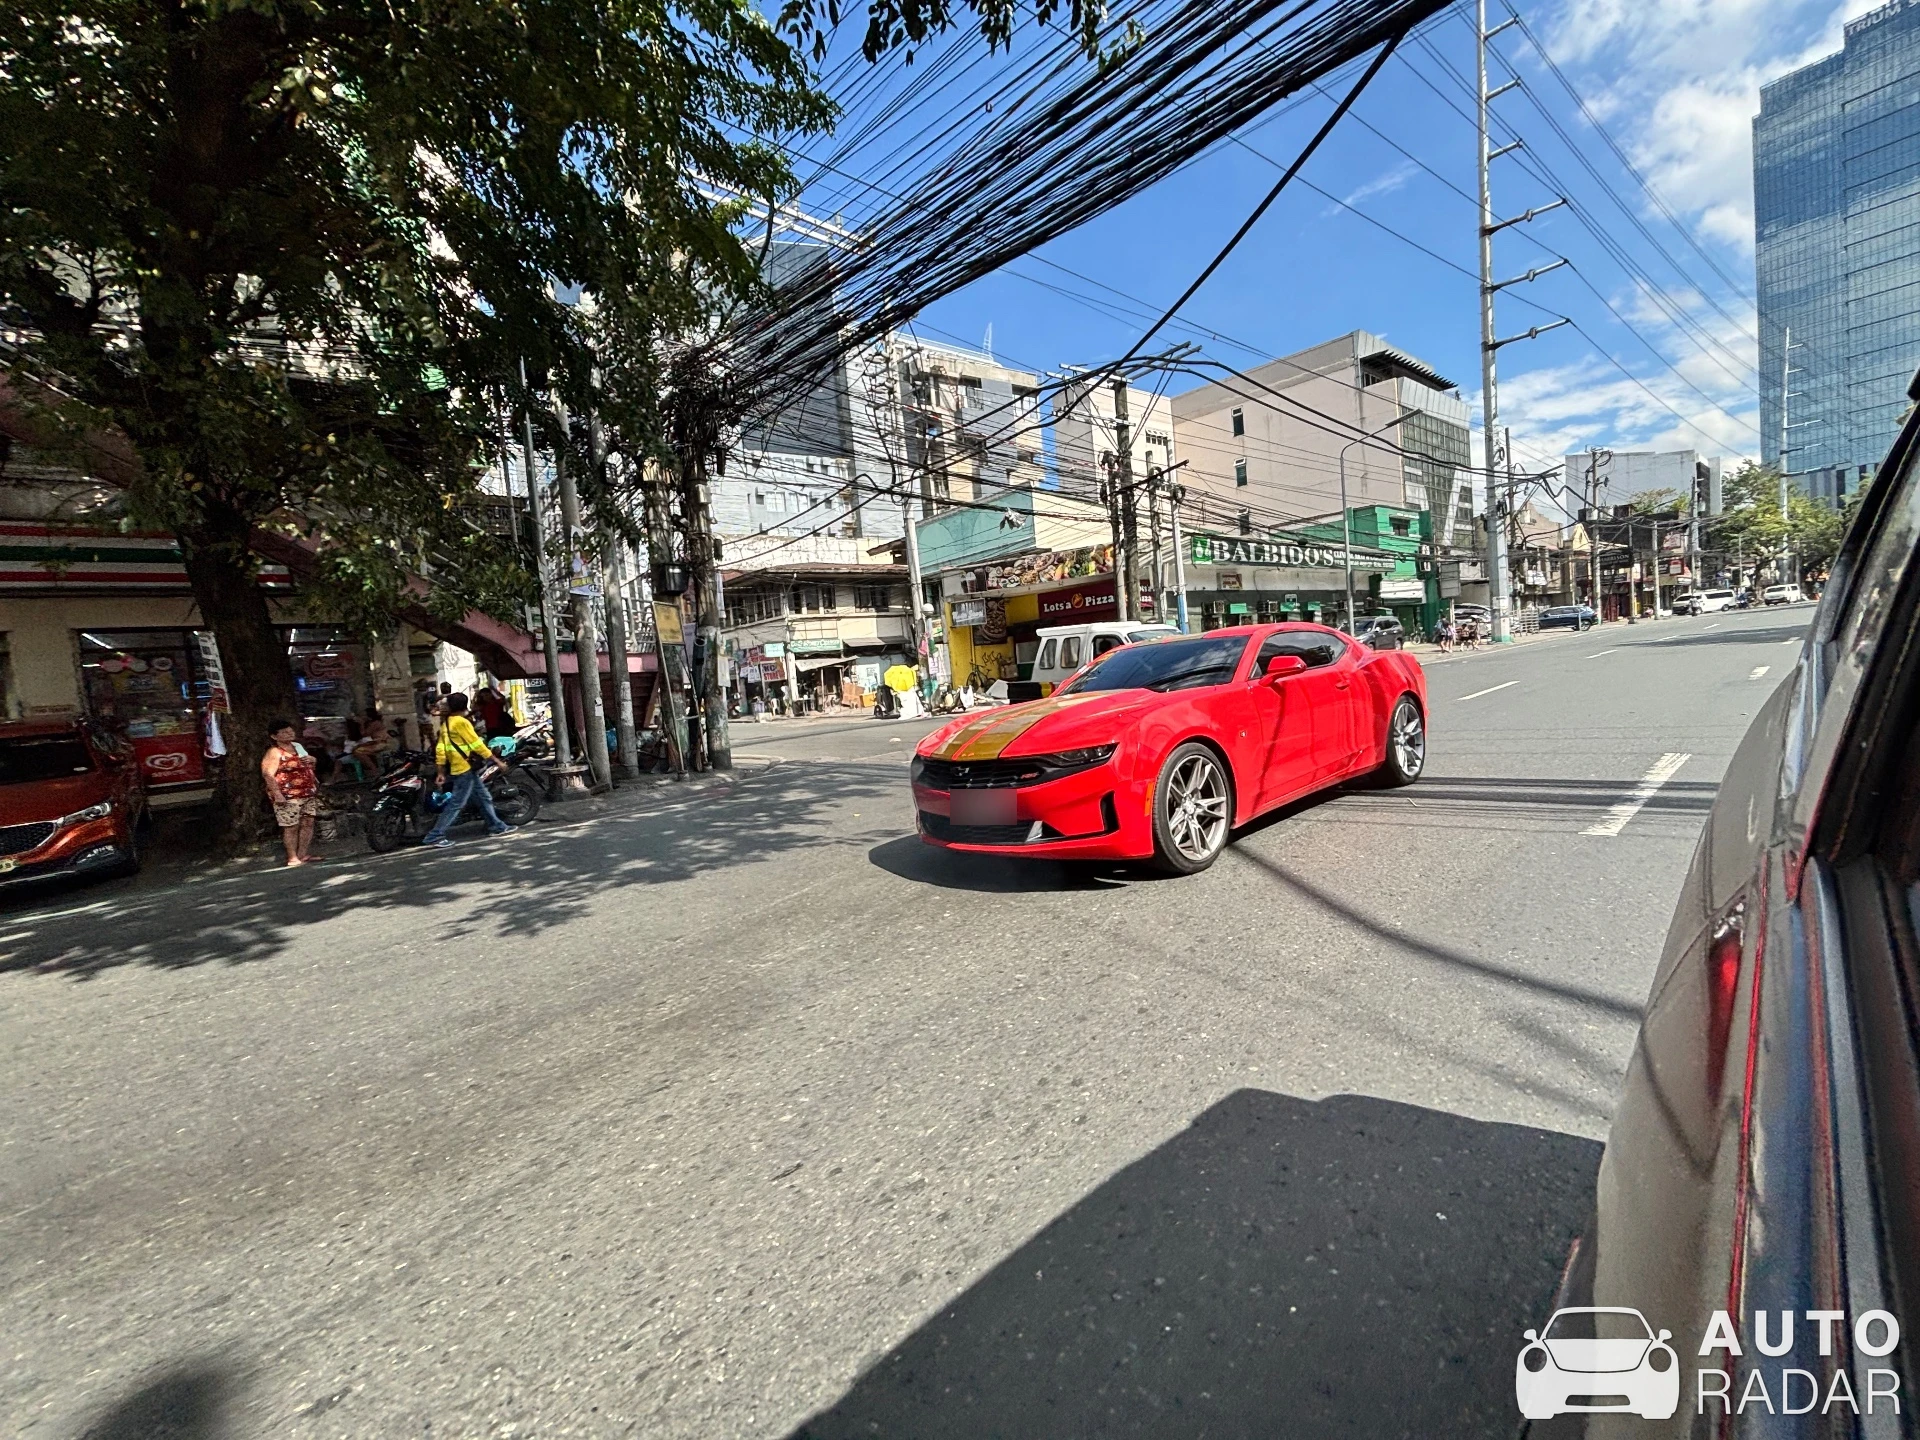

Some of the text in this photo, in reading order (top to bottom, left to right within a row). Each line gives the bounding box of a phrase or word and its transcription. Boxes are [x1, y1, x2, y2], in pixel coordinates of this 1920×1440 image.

[1212, 540, 1333, 566] BALBIDO'S
[1043, 594, 1115, 613] Lots'a Pizza
